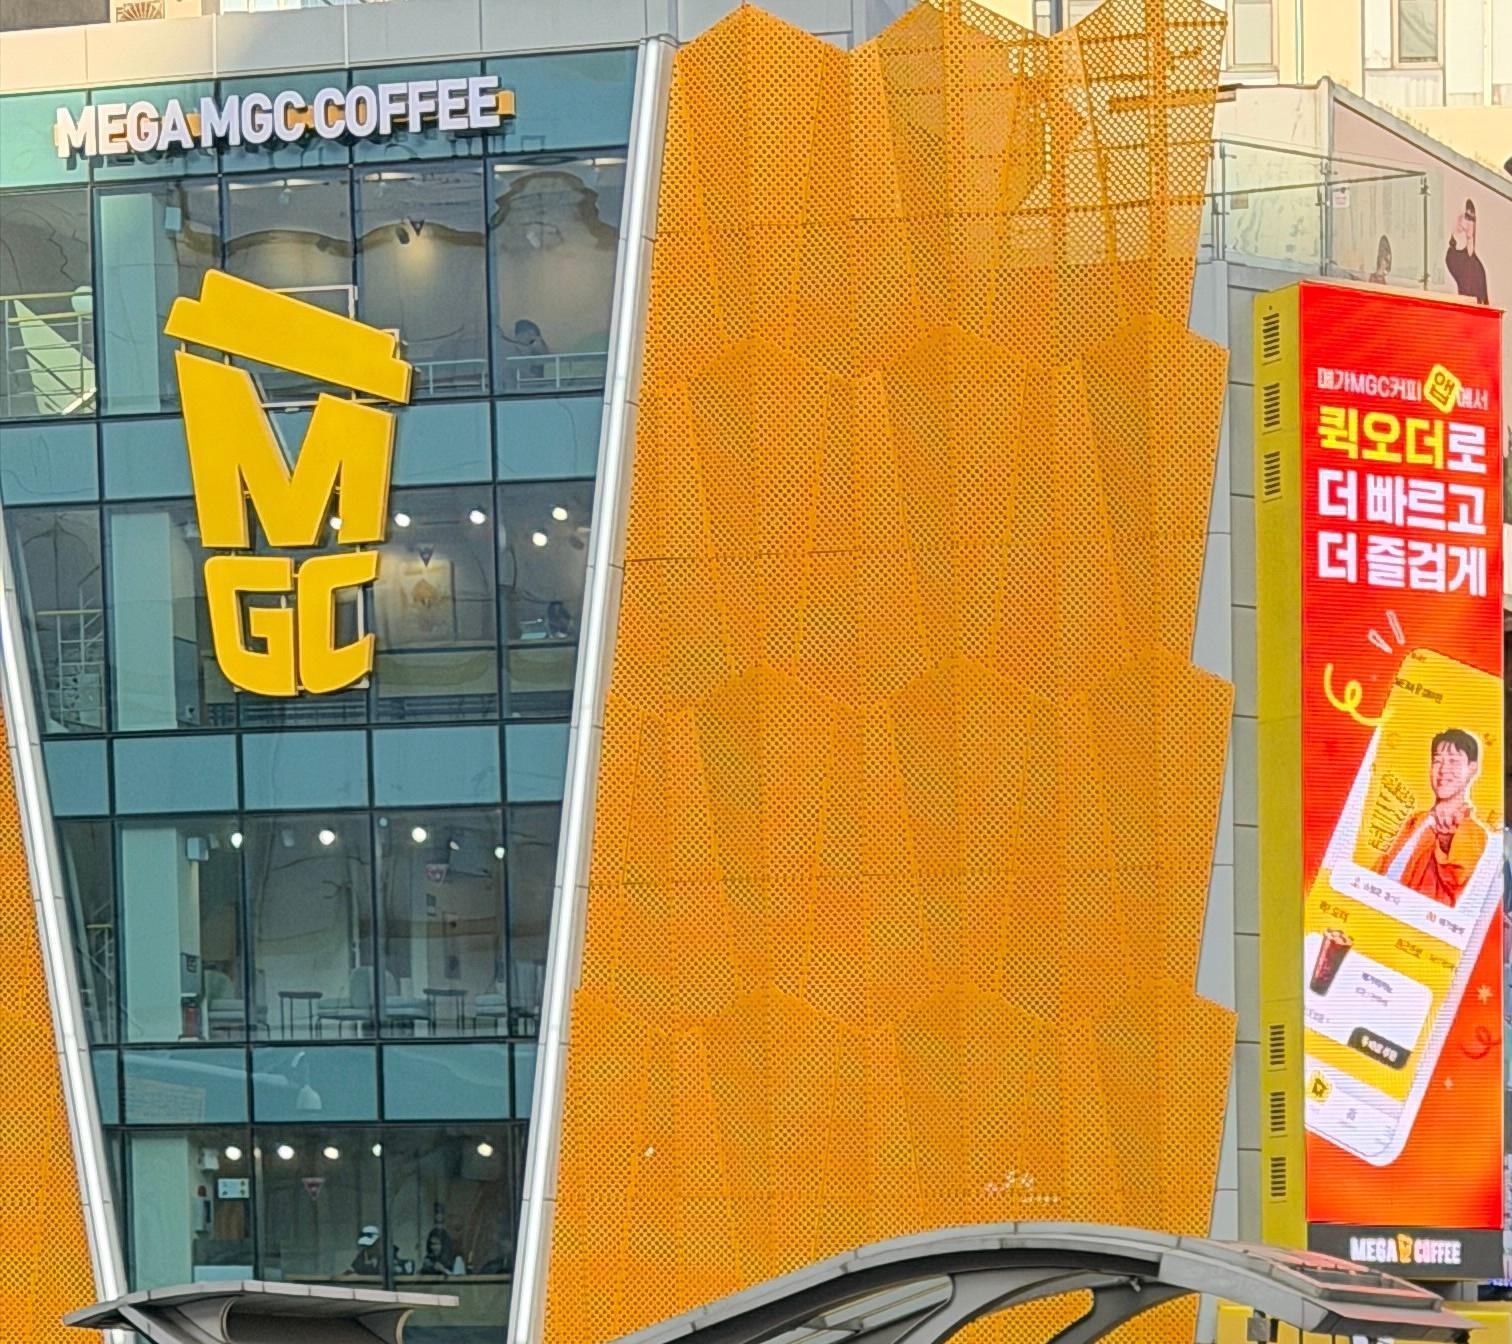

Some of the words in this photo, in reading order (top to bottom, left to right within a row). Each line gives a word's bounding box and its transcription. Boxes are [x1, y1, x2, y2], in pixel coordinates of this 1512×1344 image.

[56, 100, 194, 158] MEGA
[201, 90, 308, 147] MGC
[313, 76, 500, 138] COFFEE
[1318, 405, 1487, 474] 퀵오더로
[1318, 468, 1357, 521] 더
[1366, 473, 1487, 535] 빠르고
[1318, 530, 1357, 583] 더
[1367, 535, 1487, 597] 즐겁게
[204, 549, 379, 696] GC
[1350, 1237, 1399, 1263] MEGA
[1414, 1238, 1461, 1265] COFFEE
